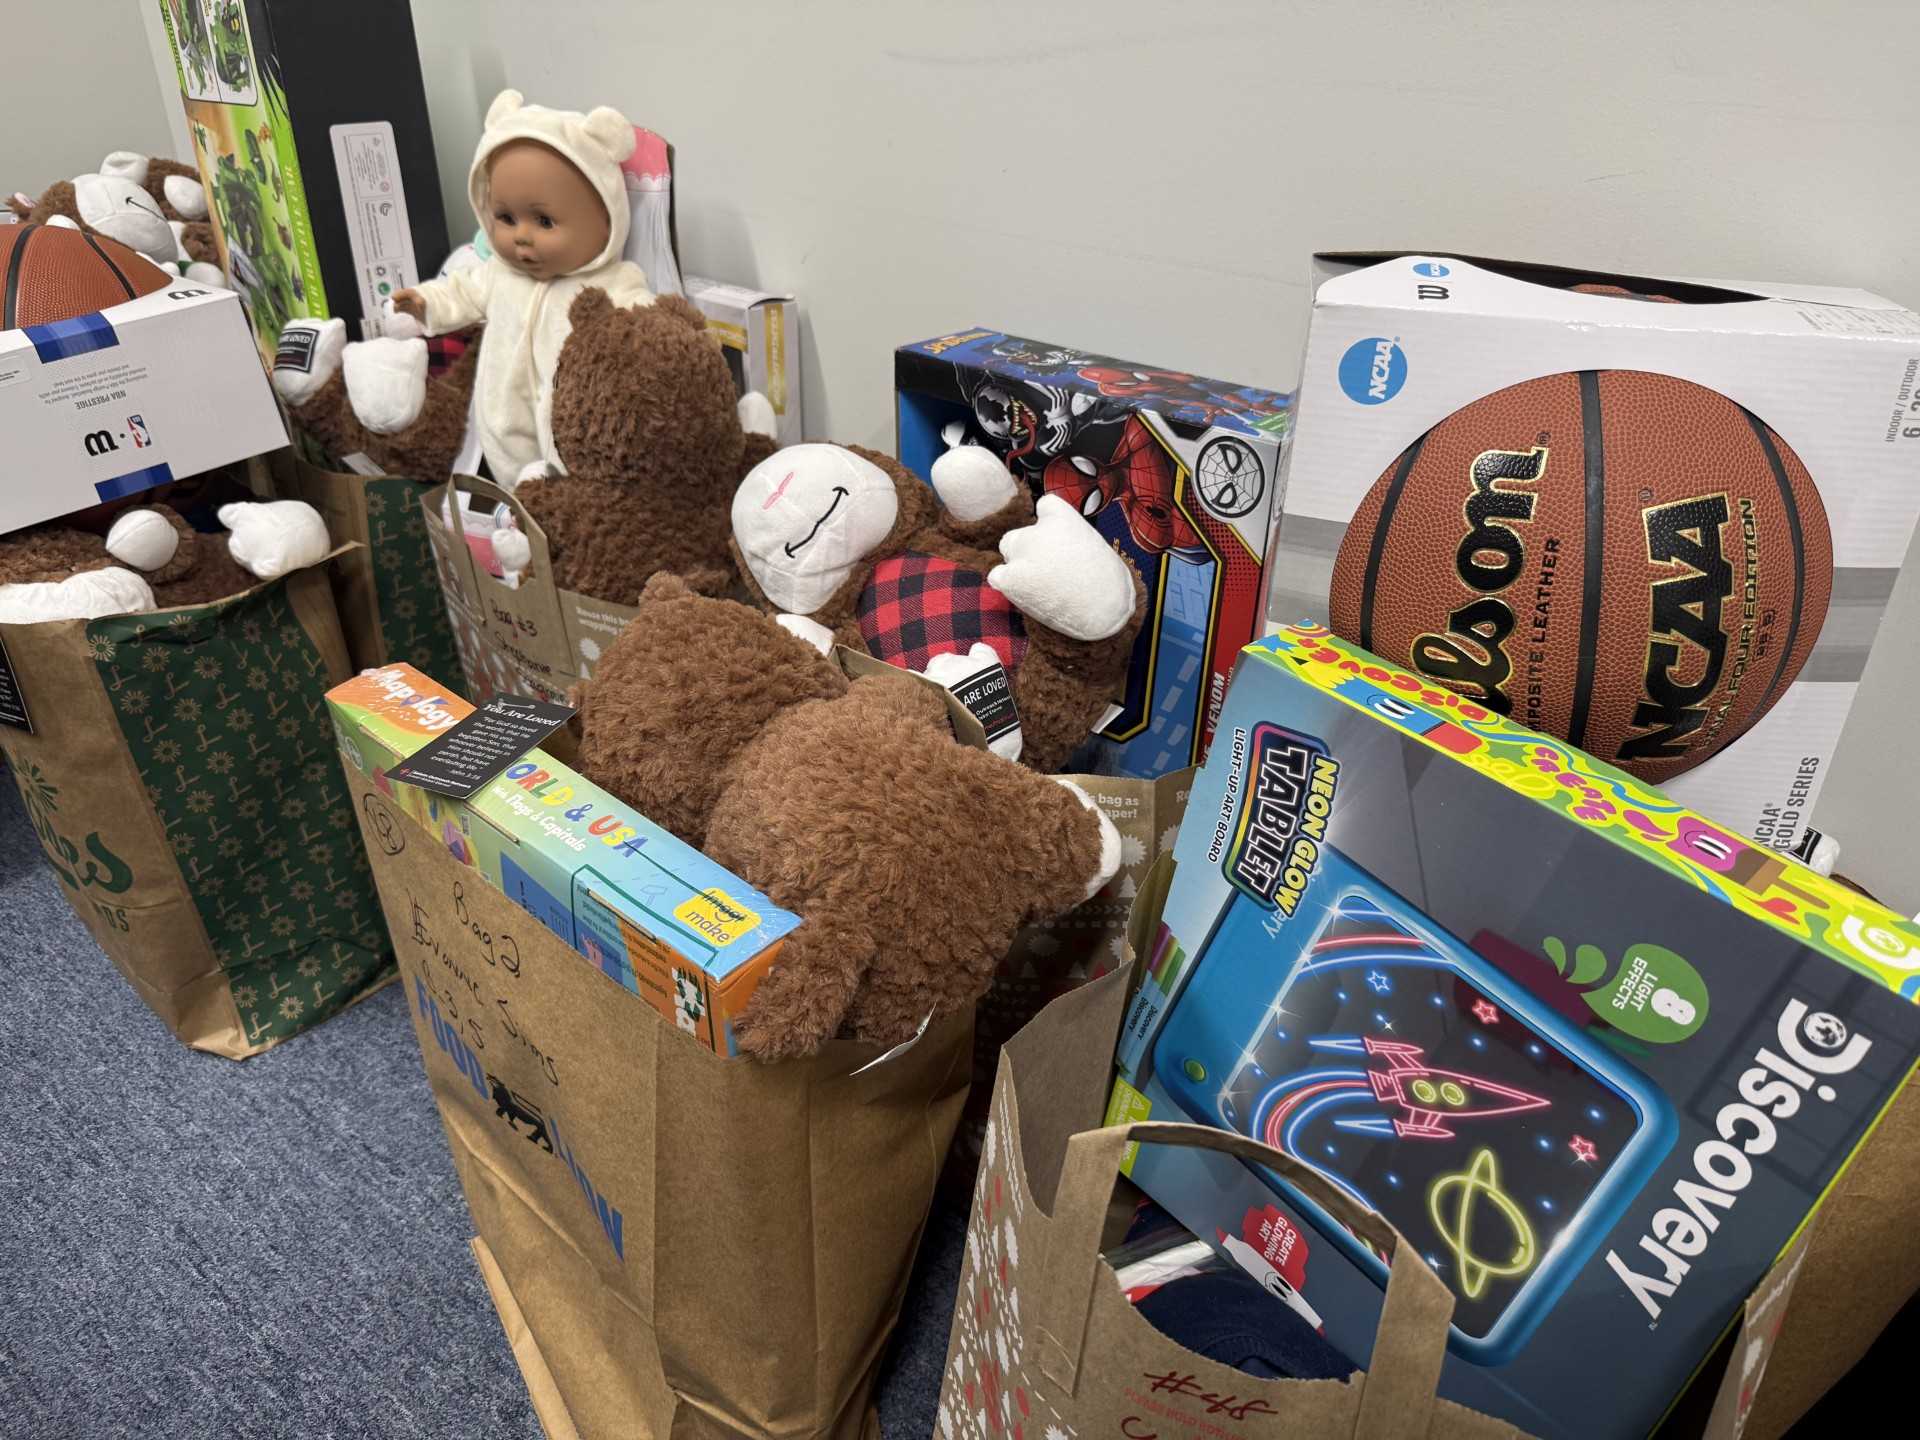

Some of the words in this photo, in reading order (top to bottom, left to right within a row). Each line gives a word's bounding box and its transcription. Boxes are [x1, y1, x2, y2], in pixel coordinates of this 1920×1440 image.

[1368, 340, 1395, 399] NCAA
[1884, 409, 1905, 442] INDOOR
[1897, 359, 1920, 401] OUTDOOR
[1410, 446, 1549, 717] lson
[1739, 496, 1758, 621] EDITION
[1531, 539, 1561, 643] LEATHER
[1616, 492, 1735, 761] NCAA
[1297, 637, 1489, 721] DISCOVER
[1728, 623, 1753, 692] FOUR
[483, 703, 506, 715] You
[506, 709, 526, 720] Are
[524, 714, 561, 727] Loved
[963, 687, 982, 706] ARE
[982, 677, 1007, 697] LOVED
[1207, 672, 1225, 734] VENOM
[1229, 728, 1247, 795] LIGHT-UP
[506, 763, 576, 806] ORLD
[564, 803, 593, 822] &
[588, 814, 649, 858] USA
[506, 791, 535, 817] Flags
[538, 814, 588, 852] Capitals
[1098, 793, 1123, 807] bag
[1124, 797, 1140, 806] as
[1103, 809, 1138, 820] aper!
[1221, 794, 1235, 822] ART
[1237, 746, 1309, 894] TABLET
[1300, 756, 1338, 841] NEON
[1774, 810, 1800, 852] GOLD
[1787, 756, 1820, 808] SERIES
[1208, 821, 1229, 863] BOARD
[1274, 838, 1318, 916] GLOW
[684, 911, 731, 943] make
[1612, 956, 1649, 1011] EFFECTS
[1636, 973, 1659, 1013] LIGHT
[1650, 987, 1697, 1026] 8
[1604, 997, 1873, 1321] Discovery
[1258, 1218, 1270, 1243] ART
[1263, 1216, 1288, 1262] GLOWING
[1275, 1228, 1297, 1267] CREATE
